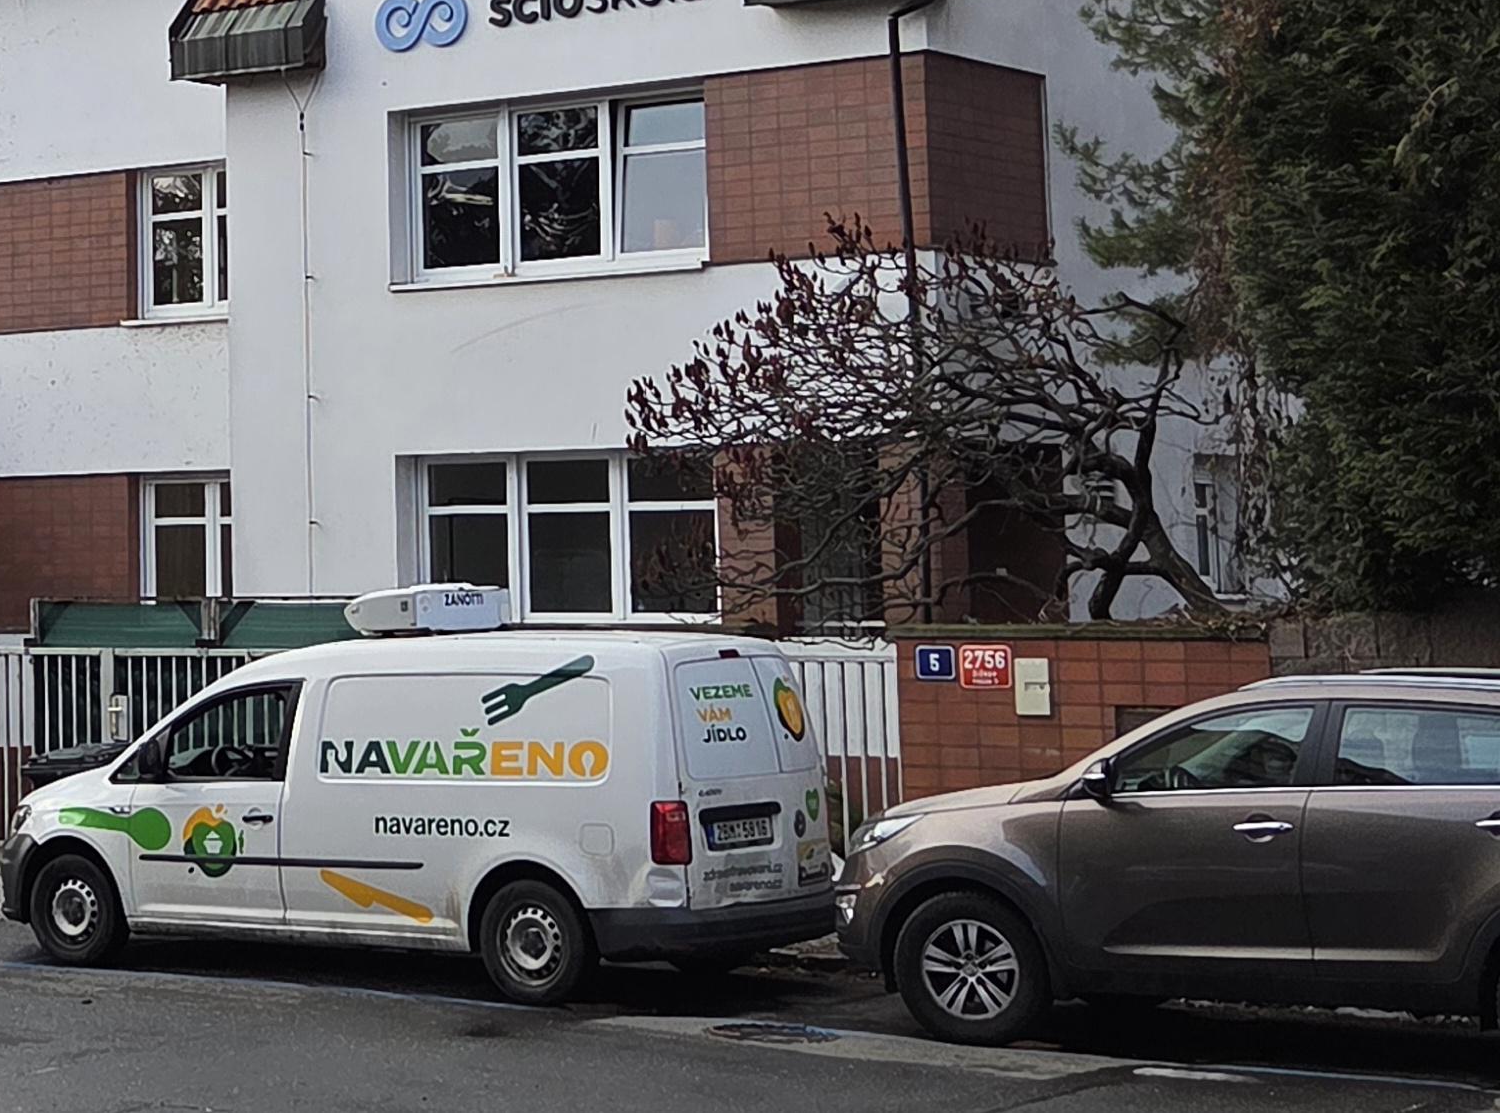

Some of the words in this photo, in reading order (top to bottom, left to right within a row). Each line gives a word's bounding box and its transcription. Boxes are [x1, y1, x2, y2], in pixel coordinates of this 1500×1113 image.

[963, 650, 1006, 670] 2756
[689, 684, 753, 702] VEZEME
[697, 703, 733, 723] VÁM
[702, 724, 747, 744] JÍDLO
[319, 728, 610, 778] NAVAŘENO
[373, 815, 511, 838] navareno.cz
